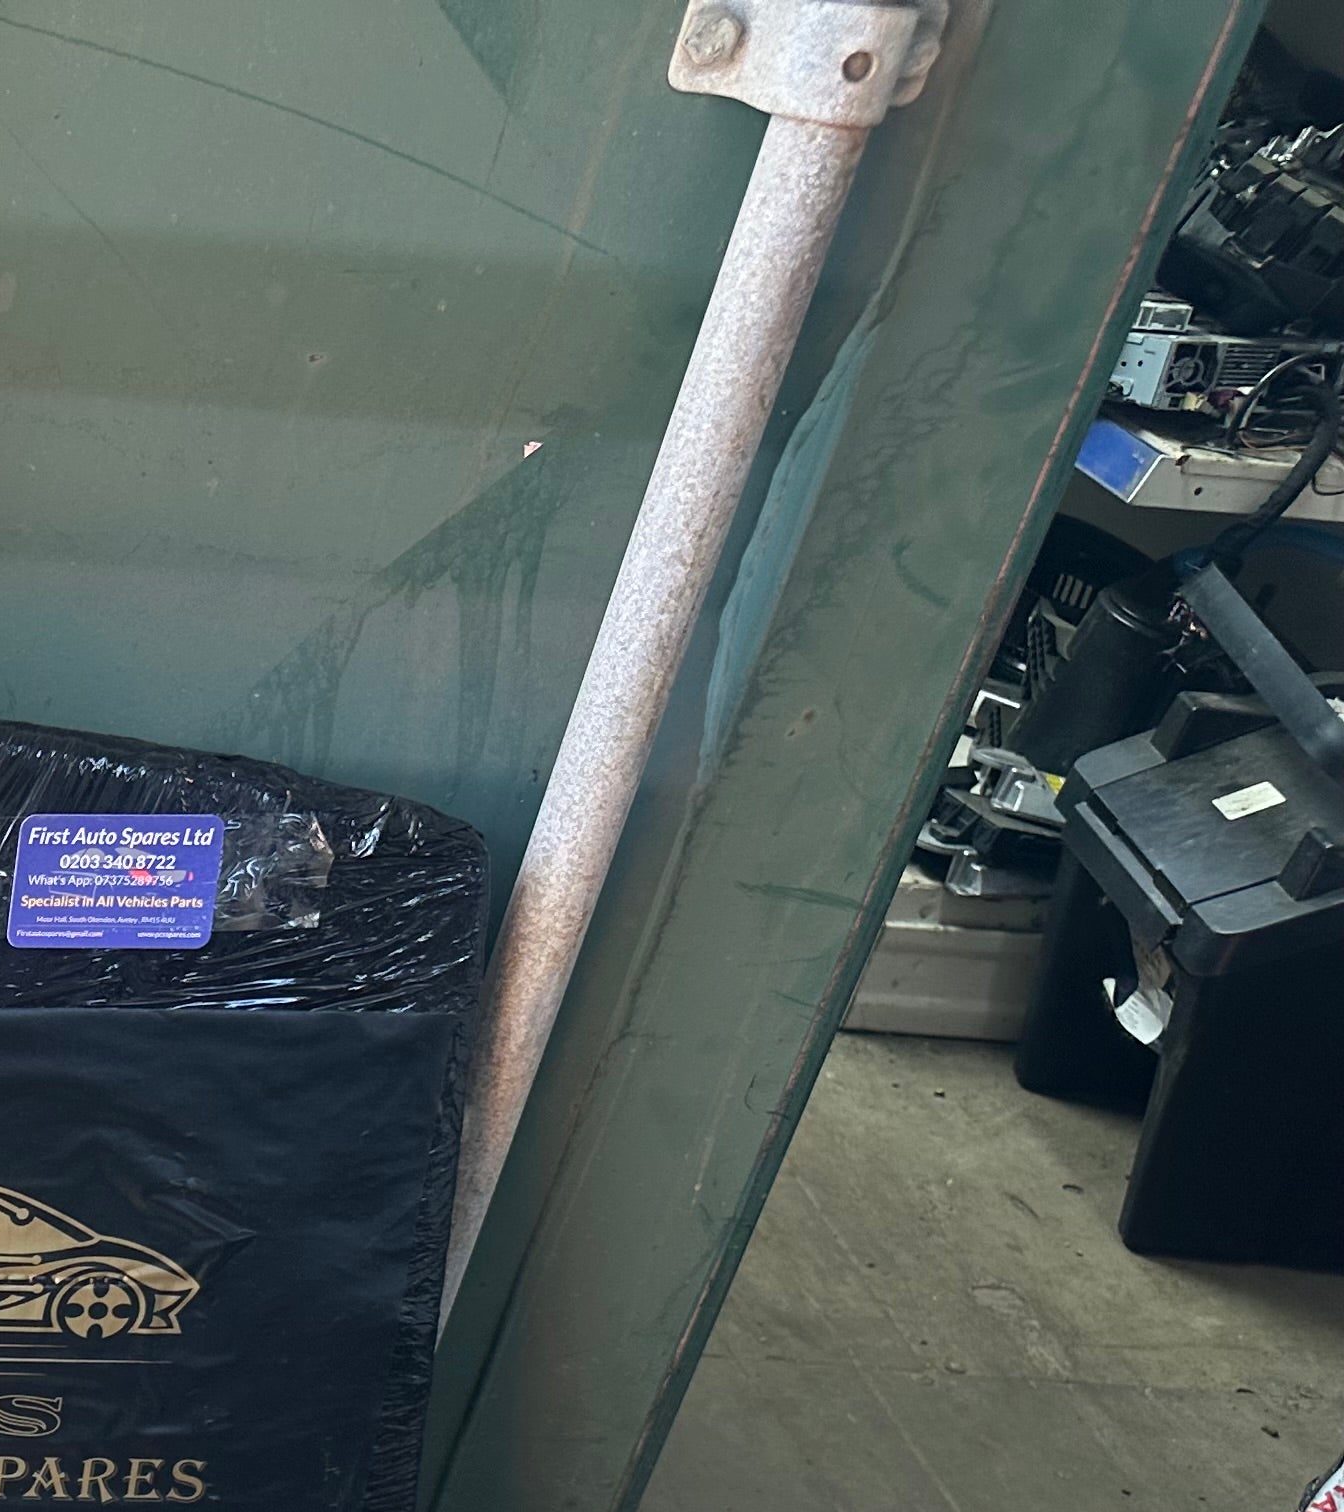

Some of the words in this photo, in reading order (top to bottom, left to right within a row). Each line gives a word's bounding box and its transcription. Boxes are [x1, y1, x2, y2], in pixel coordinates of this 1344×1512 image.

[28, 827, 70, 845] First
[71, 828, 117, 845] Auto
[119, 828, 180, 848] Spares
[183, 827, 215, 846] Ltd
[59, 854, 100, 869] 0203
[102, 855, 133, 869] 340
[135, 855, 176, 870] 8722
[28, 874, 66, 886] What's
[68, 875, 93, 888] App:
[20, 895, 80, 910] Specialist
[96, 895, 114, 908] All
[117, 896, 168, 909] Vehicles
[170, 896, 203, 909] Parts
